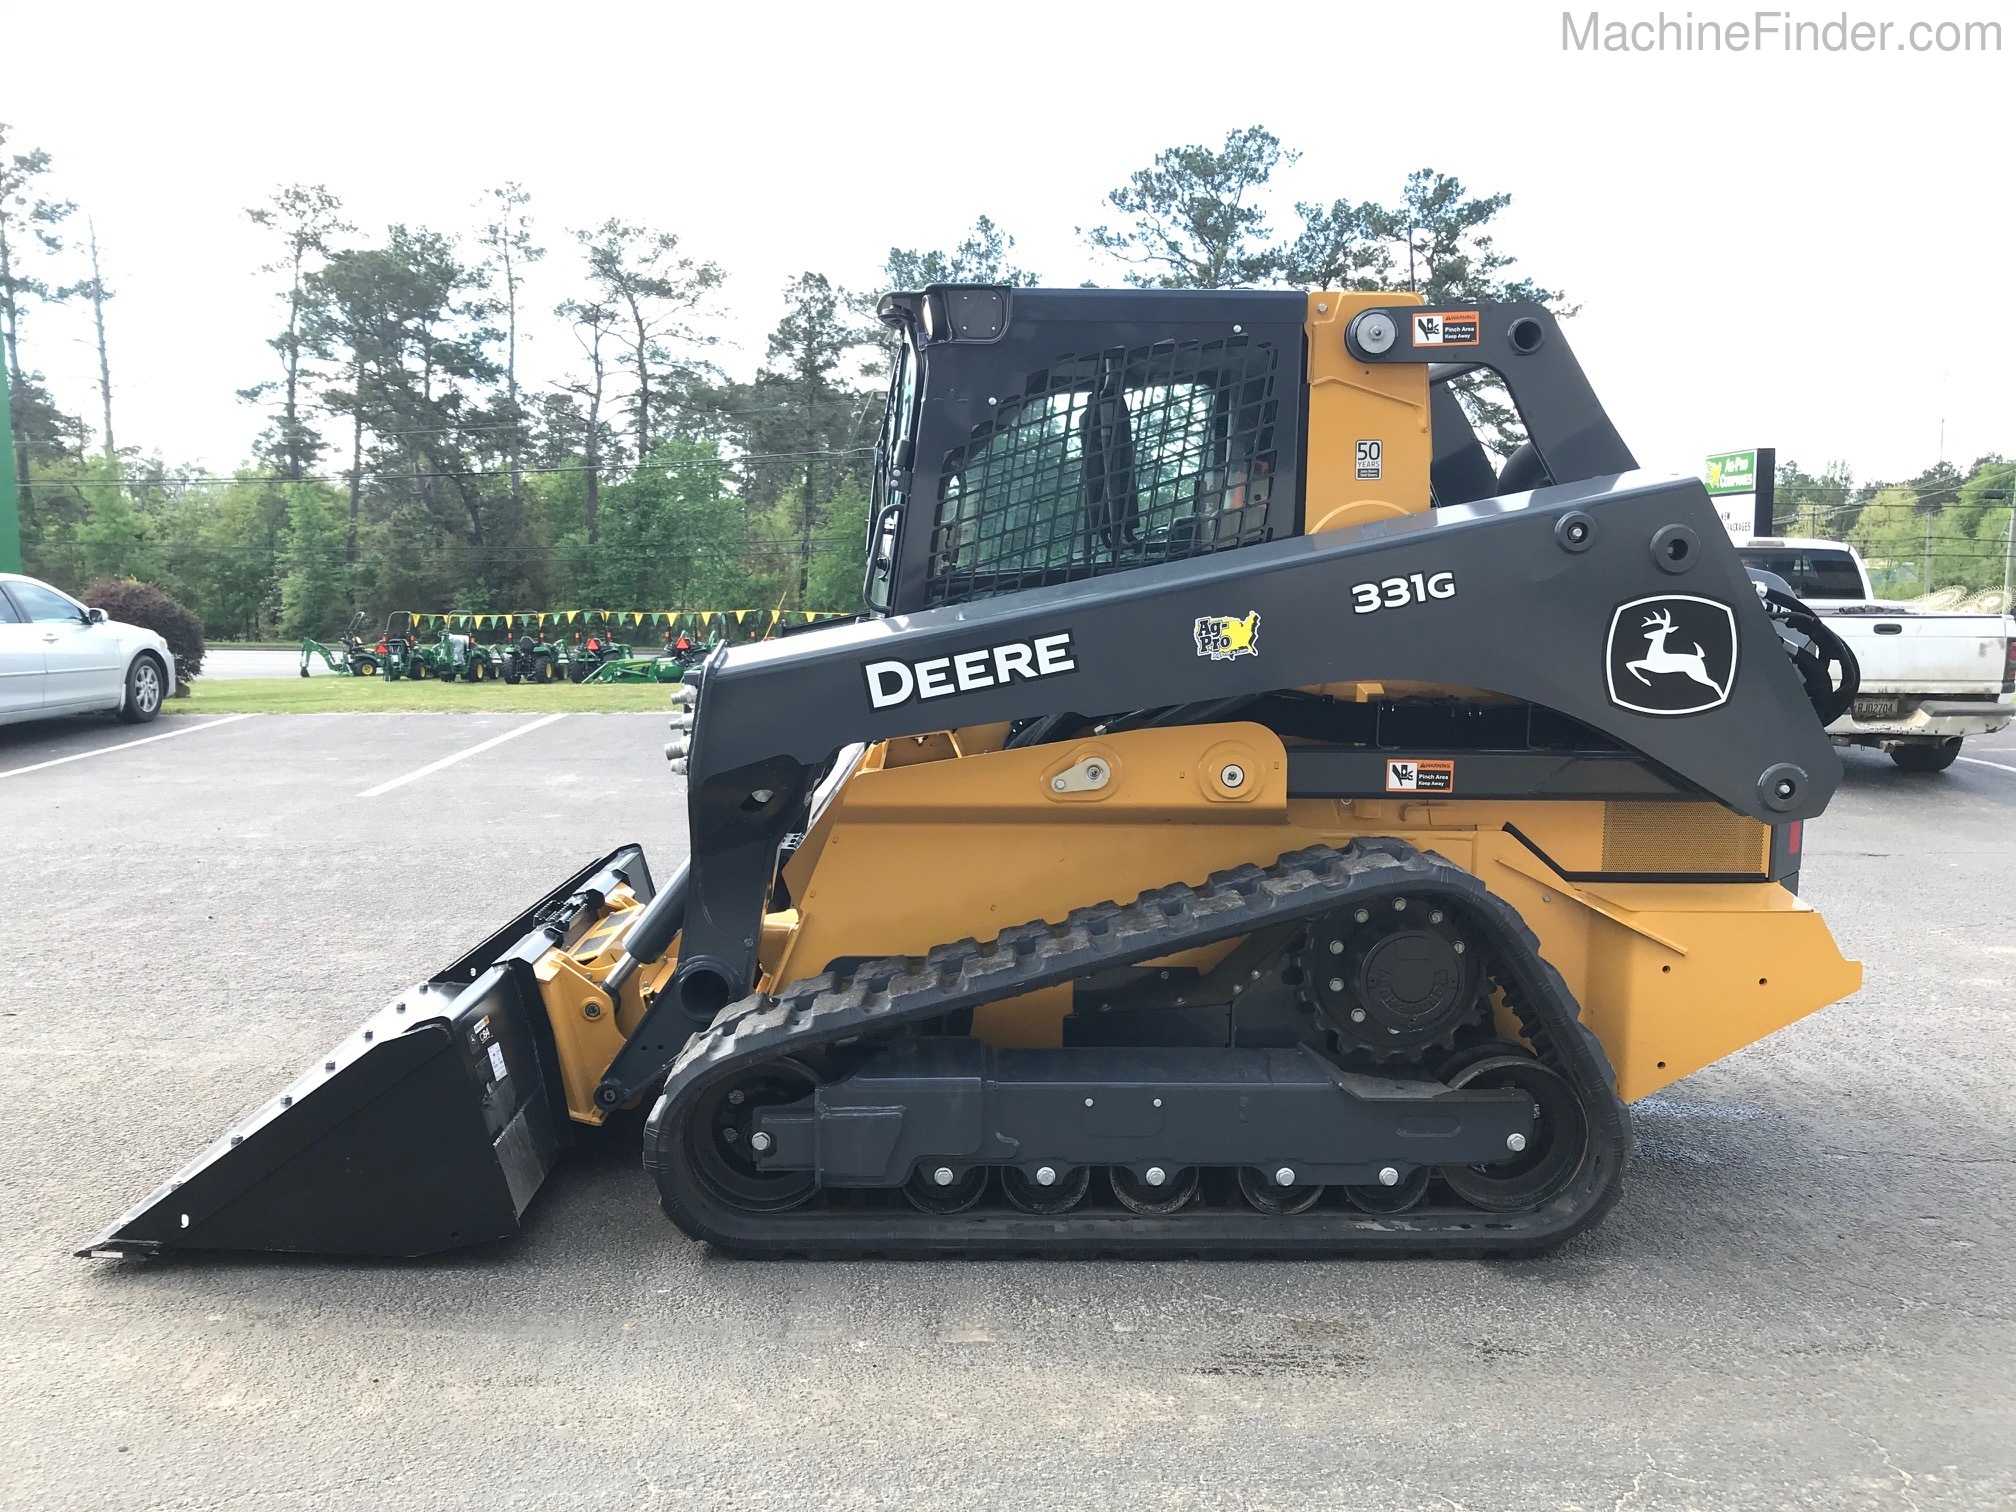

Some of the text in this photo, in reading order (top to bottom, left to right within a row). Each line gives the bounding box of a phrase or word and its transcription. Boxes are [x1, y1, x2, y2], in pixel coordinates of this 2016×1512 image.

[1357, 442, 1381, 461] 50
[1357, 460, 1380, 468] YEARS
[1351, 572, 1456, 614] 331G
[1199, 635, 1231, 653] Pro
[865, 633, 1075, 708] DEERE
